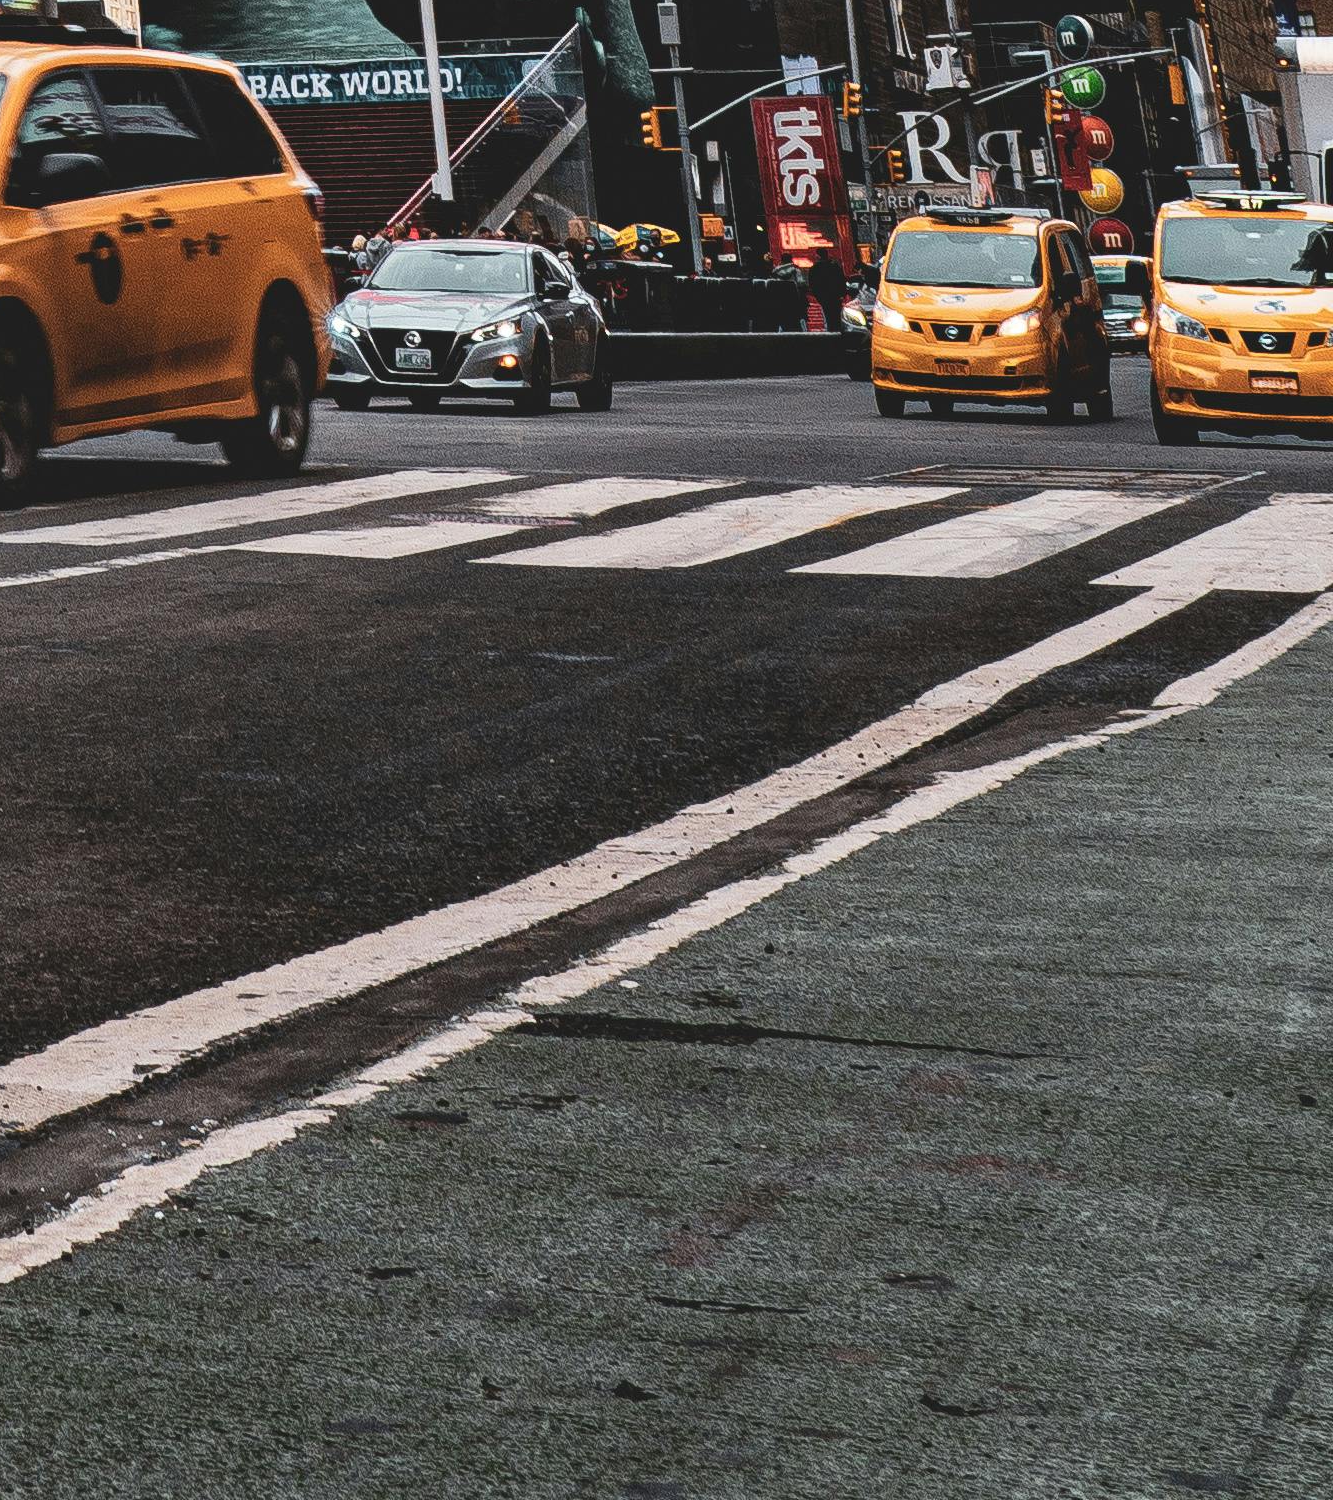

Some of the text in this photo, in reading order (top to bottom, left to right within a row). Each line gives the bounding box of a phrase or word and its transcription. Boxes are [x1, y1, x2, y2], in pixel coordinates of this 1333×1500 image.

[249, 68, 463, 99] BACK WORLD!
[773, 107, 824, 207] tkts
[896, 112, 971, 184] R
